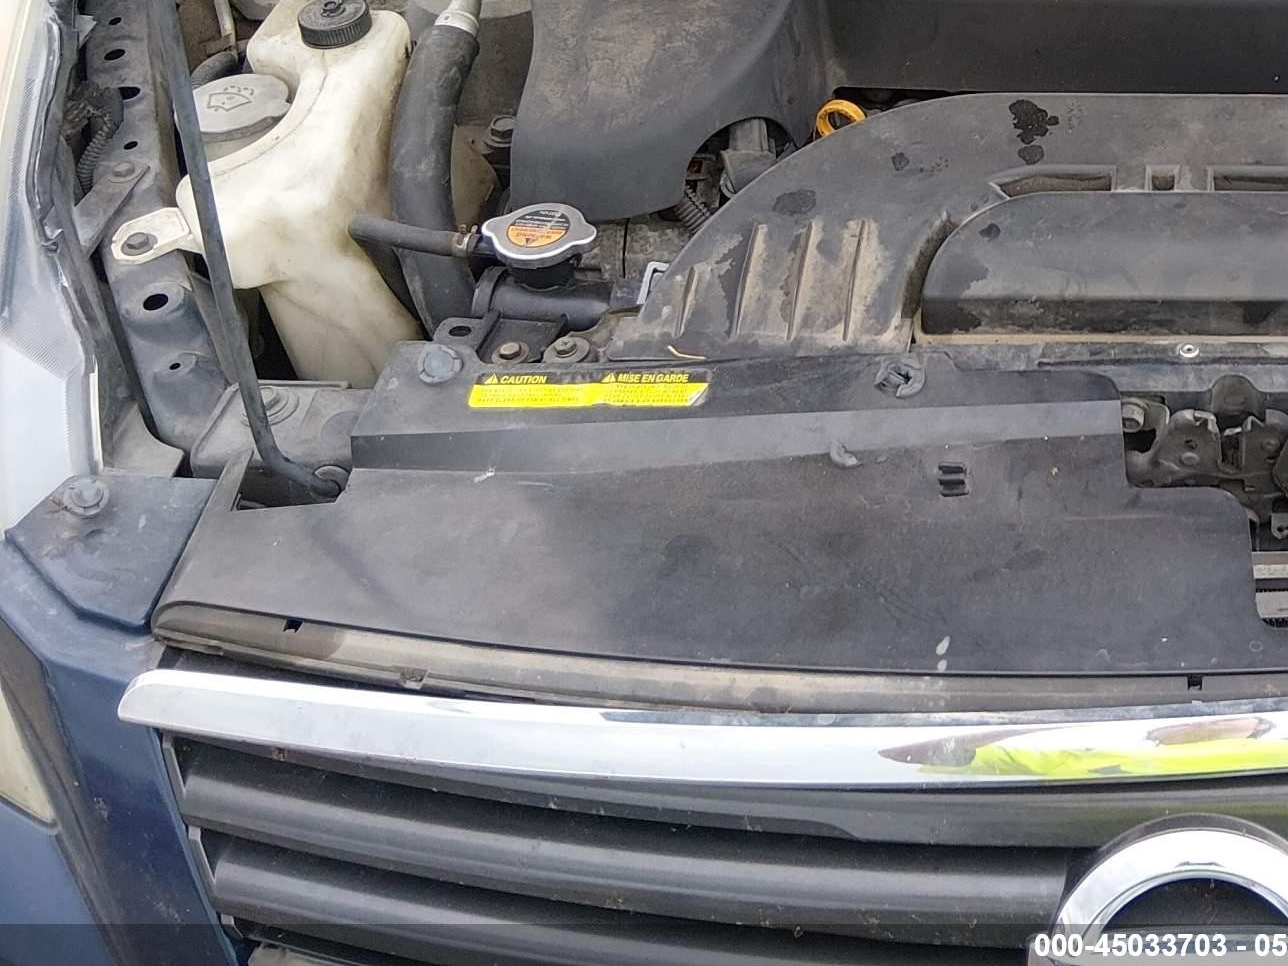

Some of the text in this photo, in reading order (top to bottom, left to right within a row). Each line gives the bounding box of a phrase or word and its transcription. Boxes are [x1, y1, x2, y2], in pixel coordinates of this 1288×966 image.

[499, 375, 548, 384] CAUTION
[617, 373, 690, 383] MISE EN GARDE
